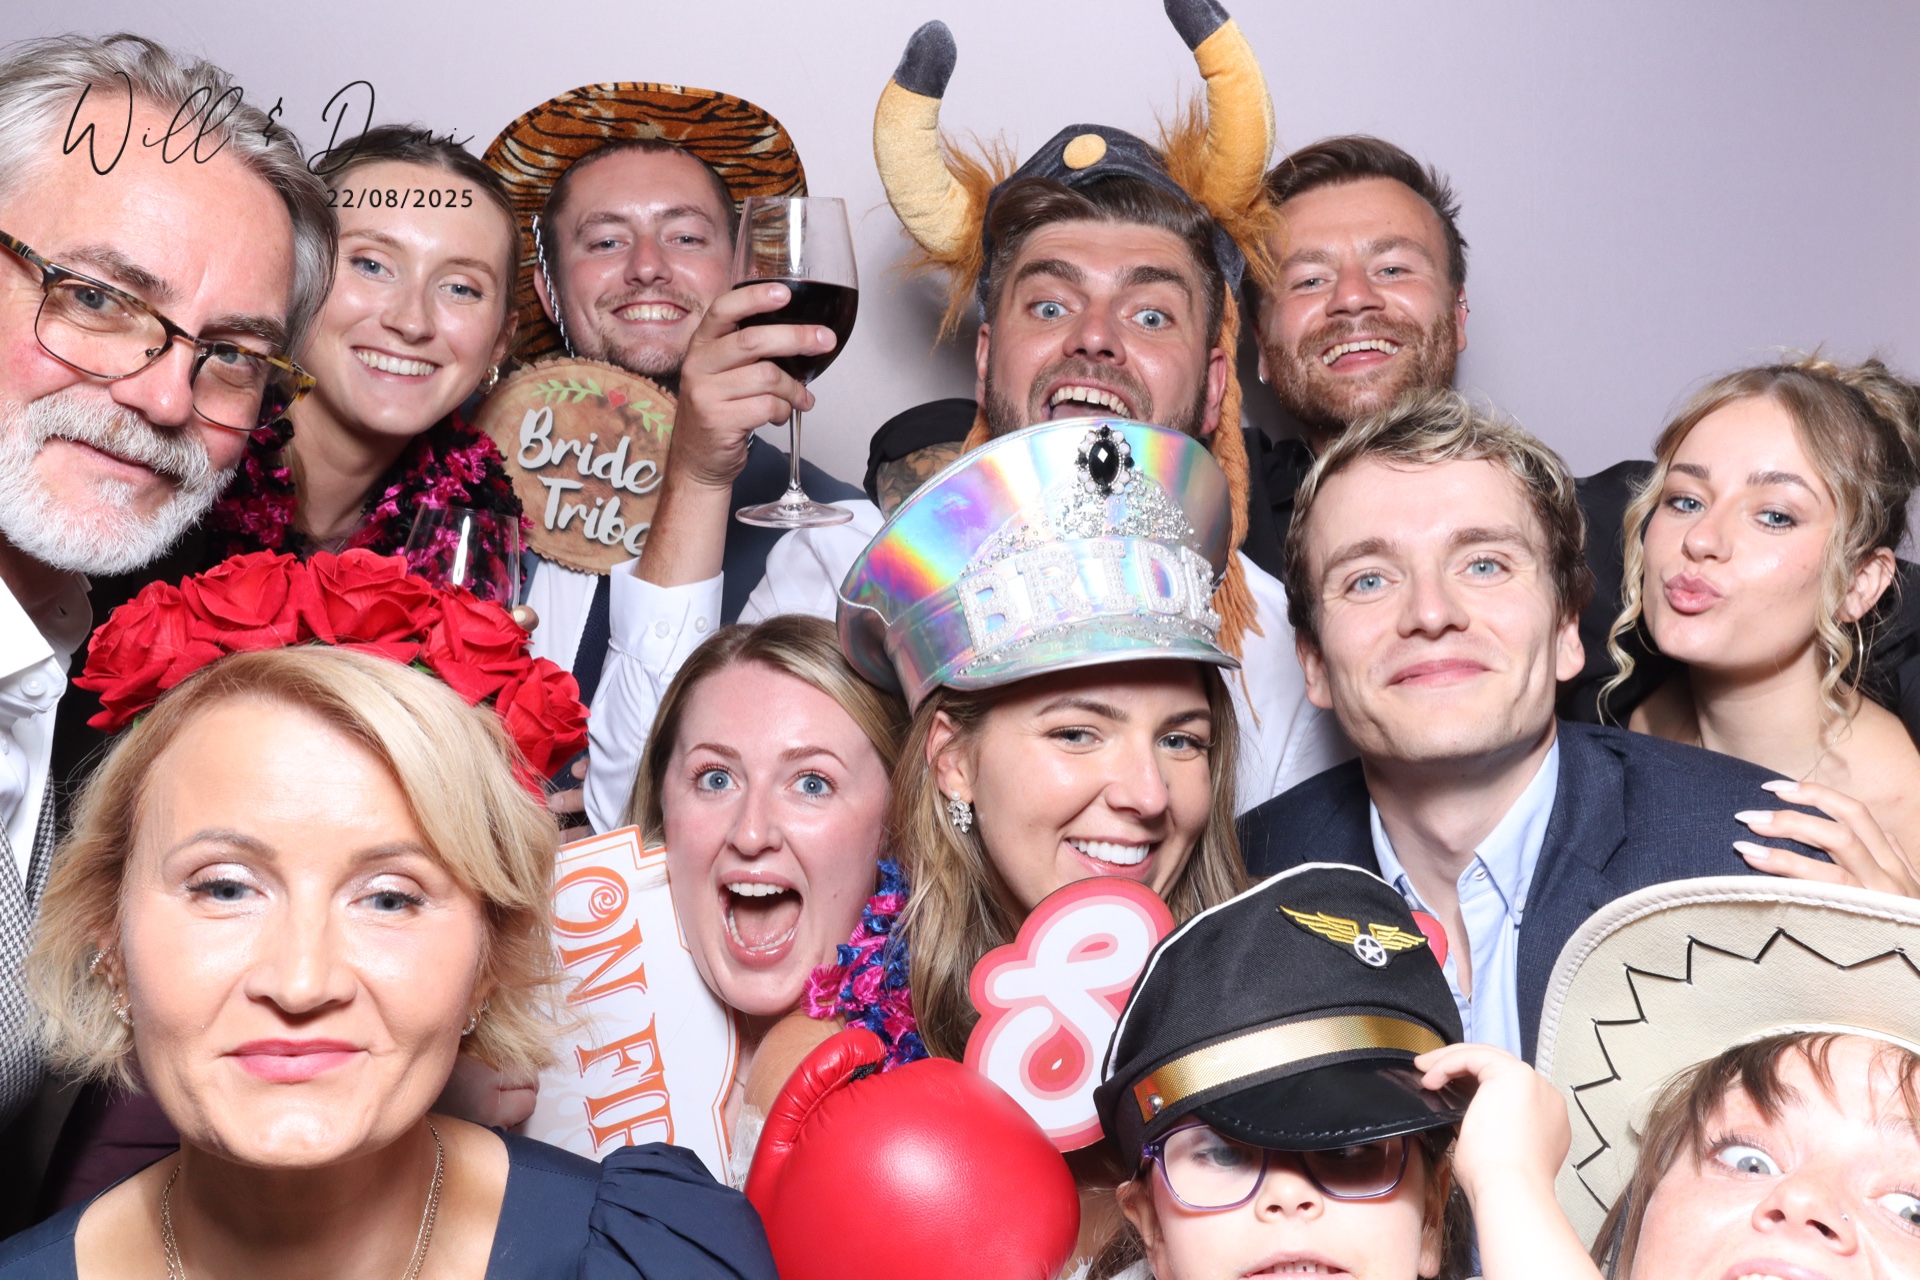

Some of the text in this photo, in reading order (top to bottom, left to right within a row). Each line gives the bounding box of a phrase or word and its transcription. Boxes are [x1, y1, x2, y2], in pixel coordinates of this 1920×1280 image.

[517, 406, 663, 494] Bride
[537, 475, 651, 556] Tribe
[956, 539, 1222, 655] BRIDE
[550, 866, 648, 1007] ON
